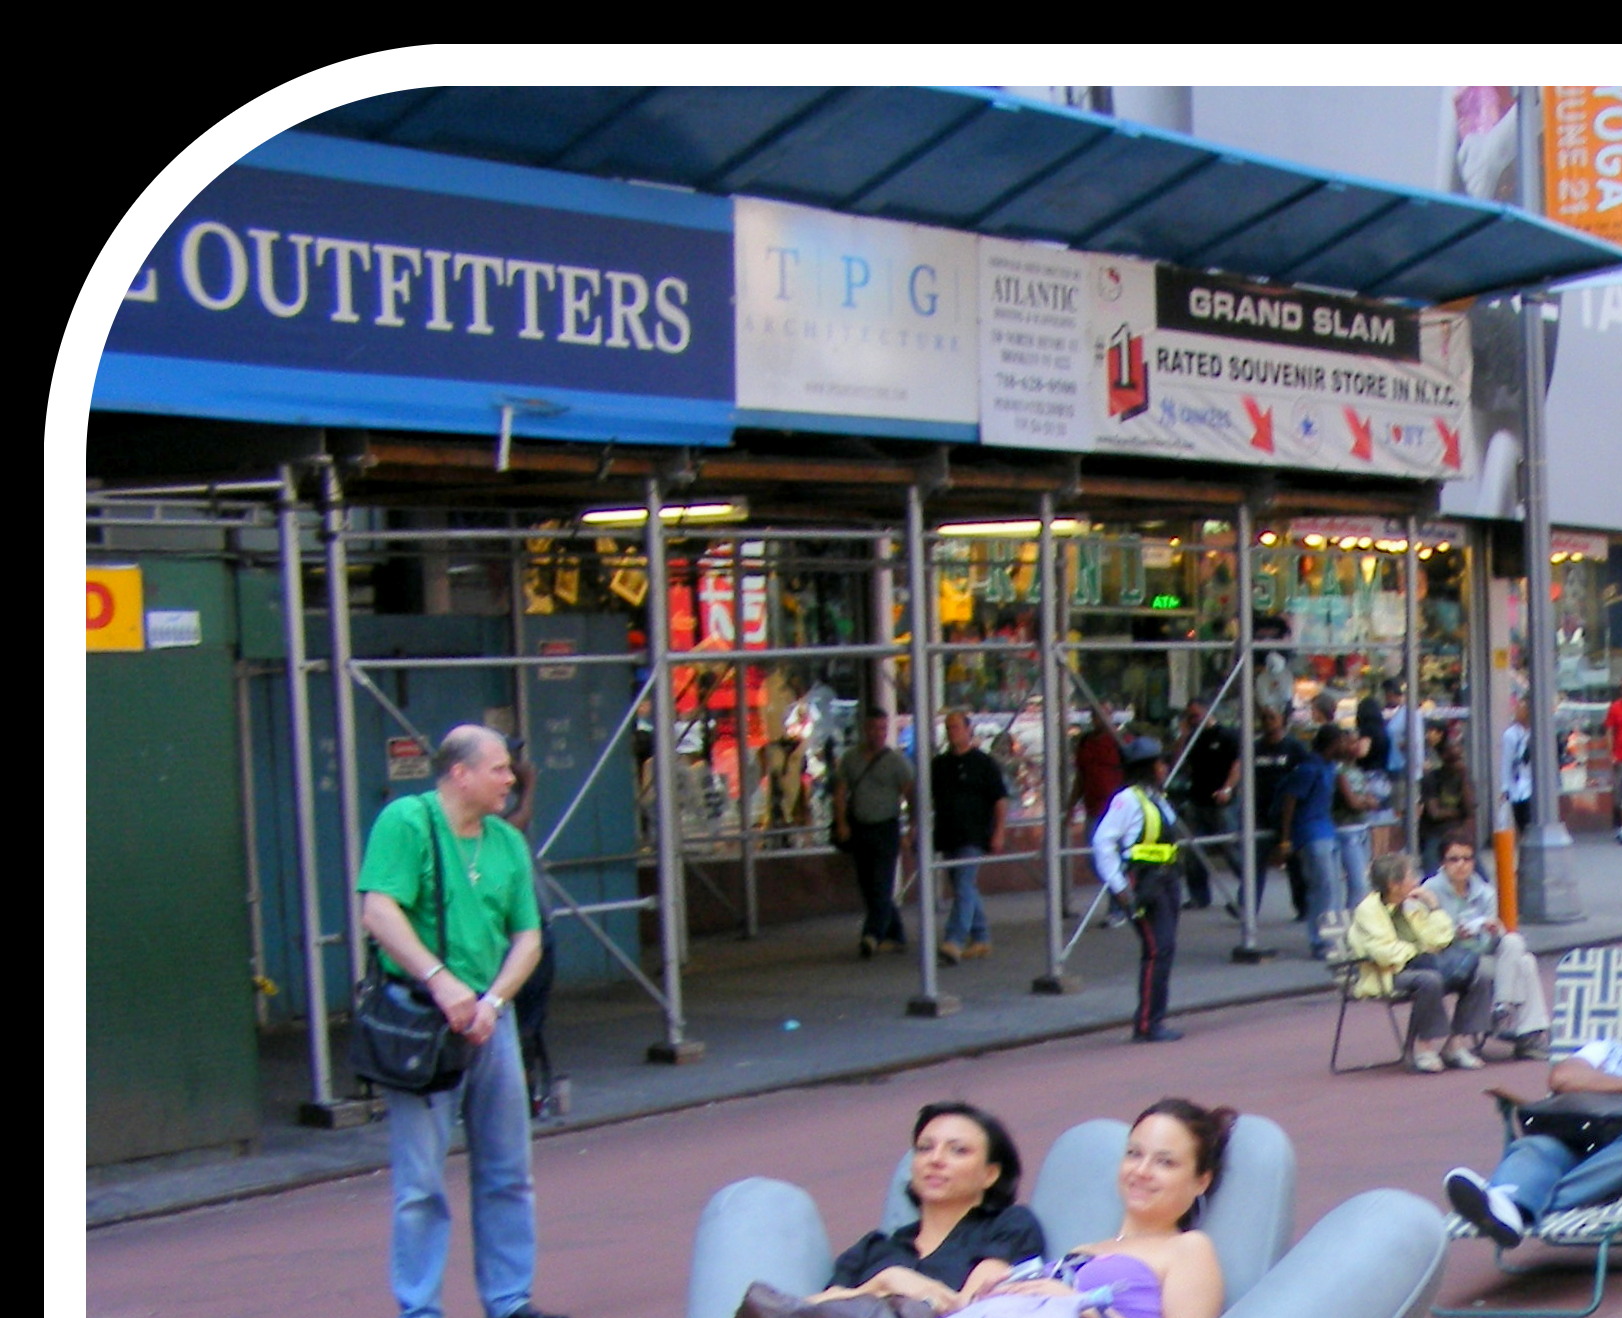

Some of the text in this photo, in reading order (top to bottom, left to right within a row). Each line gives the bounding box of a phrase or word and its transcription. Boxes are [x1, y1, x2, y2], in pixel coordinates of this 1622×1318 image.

[1555, 86, 1591, 216] JUNE 21
[180, 221, 692, 354] OUTFITTERS
[992, 275, 1079, 312] ATLANTIC
[1189, 287, 1396, 346] GRAND SLAM
[1157, 347, 1222, 378] RATED
[1228, 355, 1326, 390] SOUVENIR
[1331, 367, 1388, 398] STORE
[1392, 377, 1410, 401] IN
[1415, 379, 1460, 406] N.Y.C.
